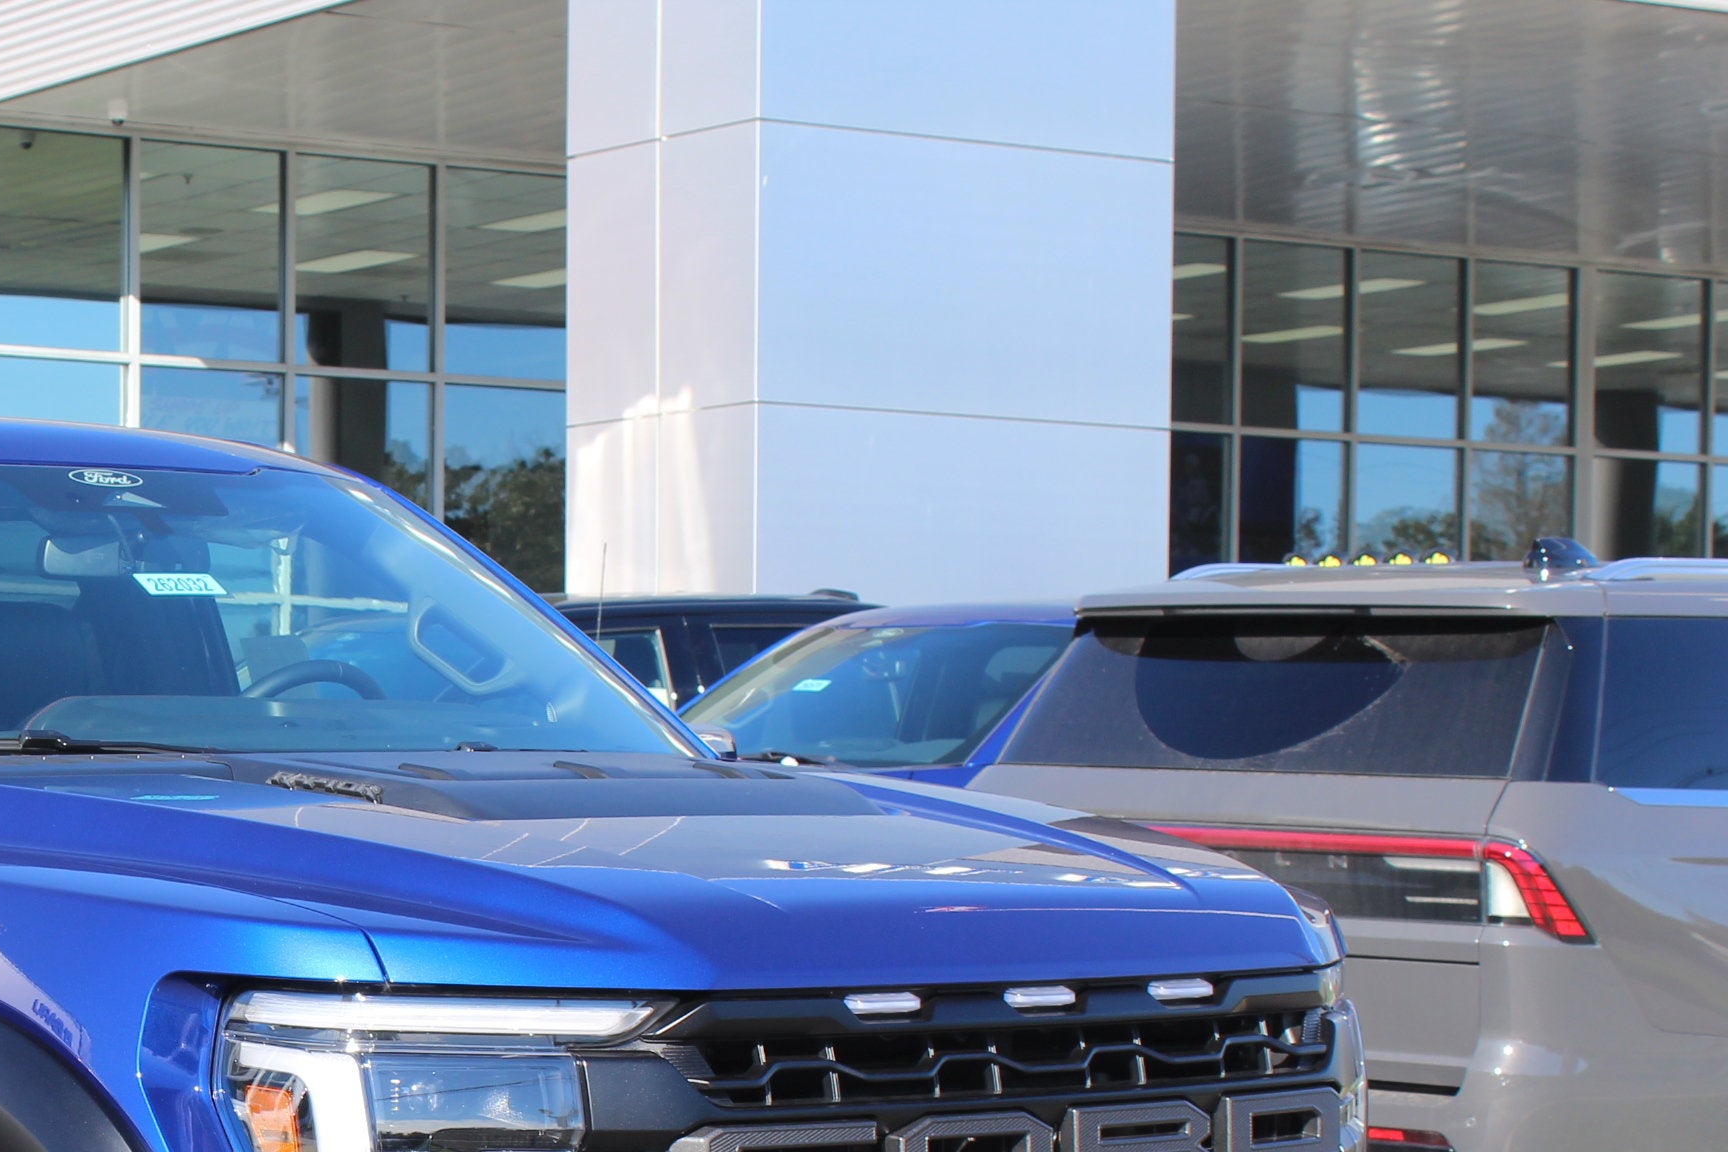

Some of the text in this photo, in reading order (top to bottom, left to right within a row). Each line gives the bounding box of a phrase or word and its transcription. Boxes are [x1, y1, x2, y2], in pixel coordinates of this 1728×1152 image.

[83, 470, 132, 485] Ford
[146, 577, 215, 592] 262032
[265, 770, 384, 804] RAPTOR
